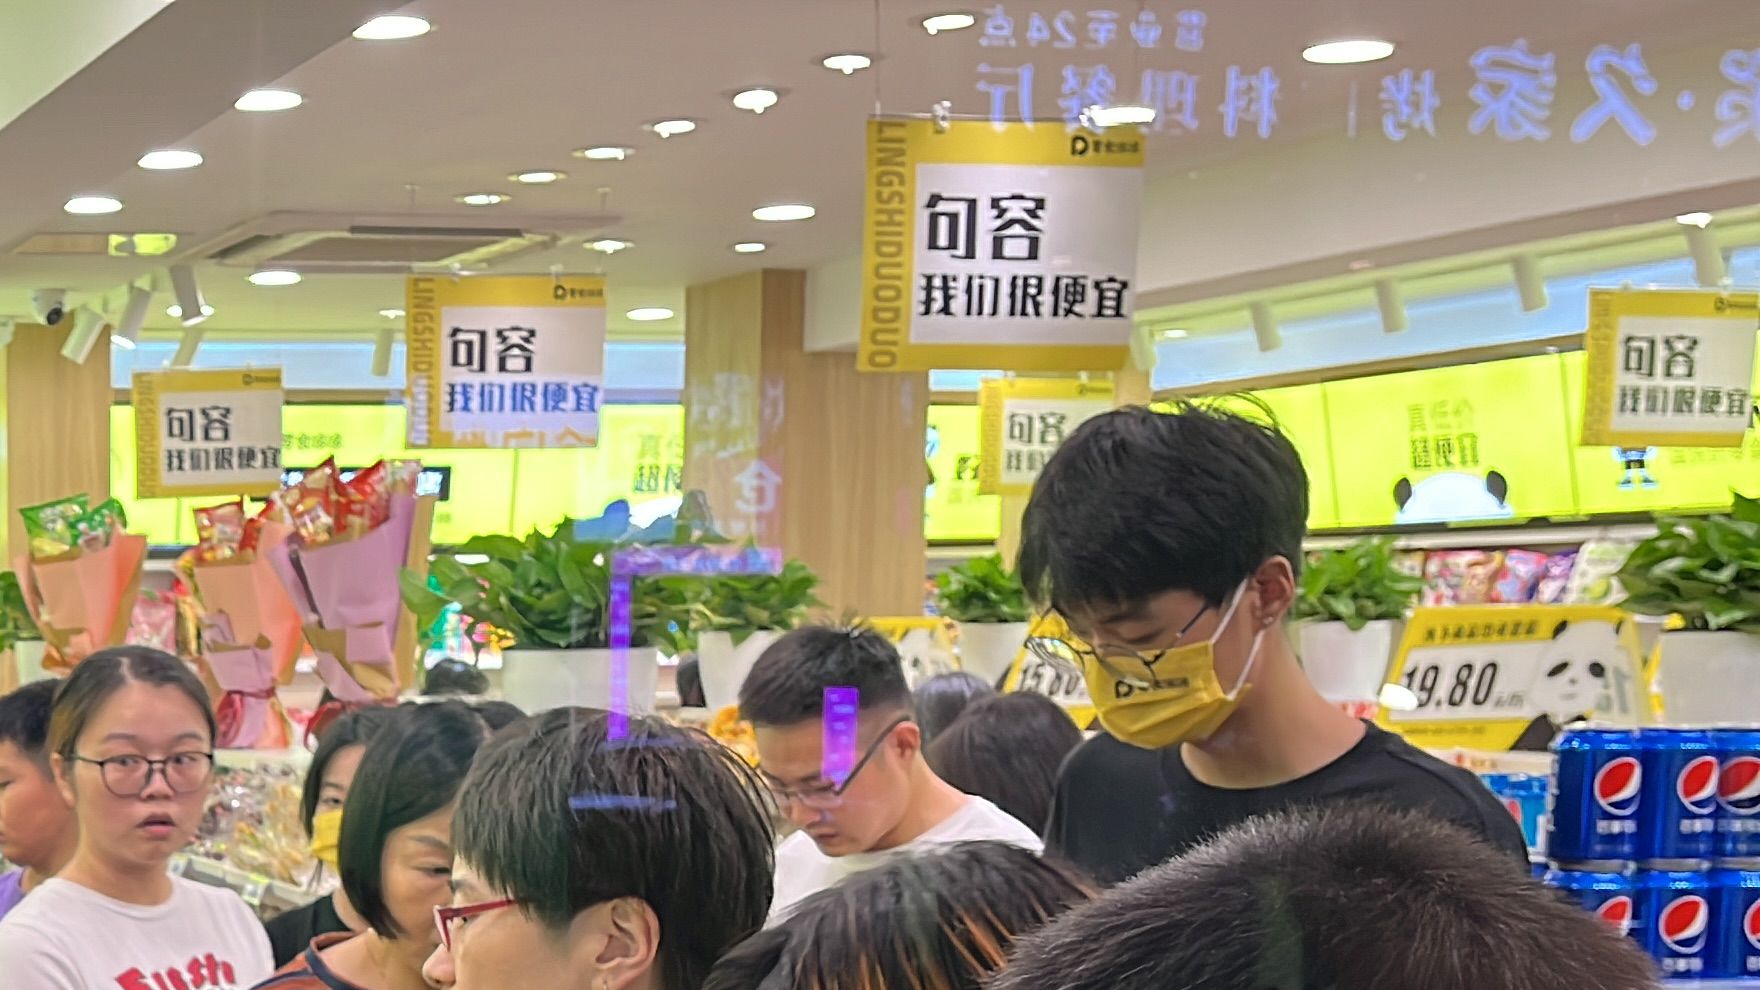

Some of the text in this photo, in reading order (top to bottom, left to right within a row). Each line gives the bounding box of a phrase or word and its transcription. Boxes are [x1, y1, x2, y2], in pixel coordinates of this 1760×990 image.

[868, 122, 906, 367] LINGSHIDUODUO
[924, 194, 1045, 260] 句容
[919, 274, 1129, 319] 我们很便宜
[449, 326, 537, 374] 句容
[1624, 334, 1698, 378] 句容
[447, 381, 598, 414] 我们很便宜
[165, 405, 231, 442] 句容
[165, 446, 282, 472] 我们很便宜
